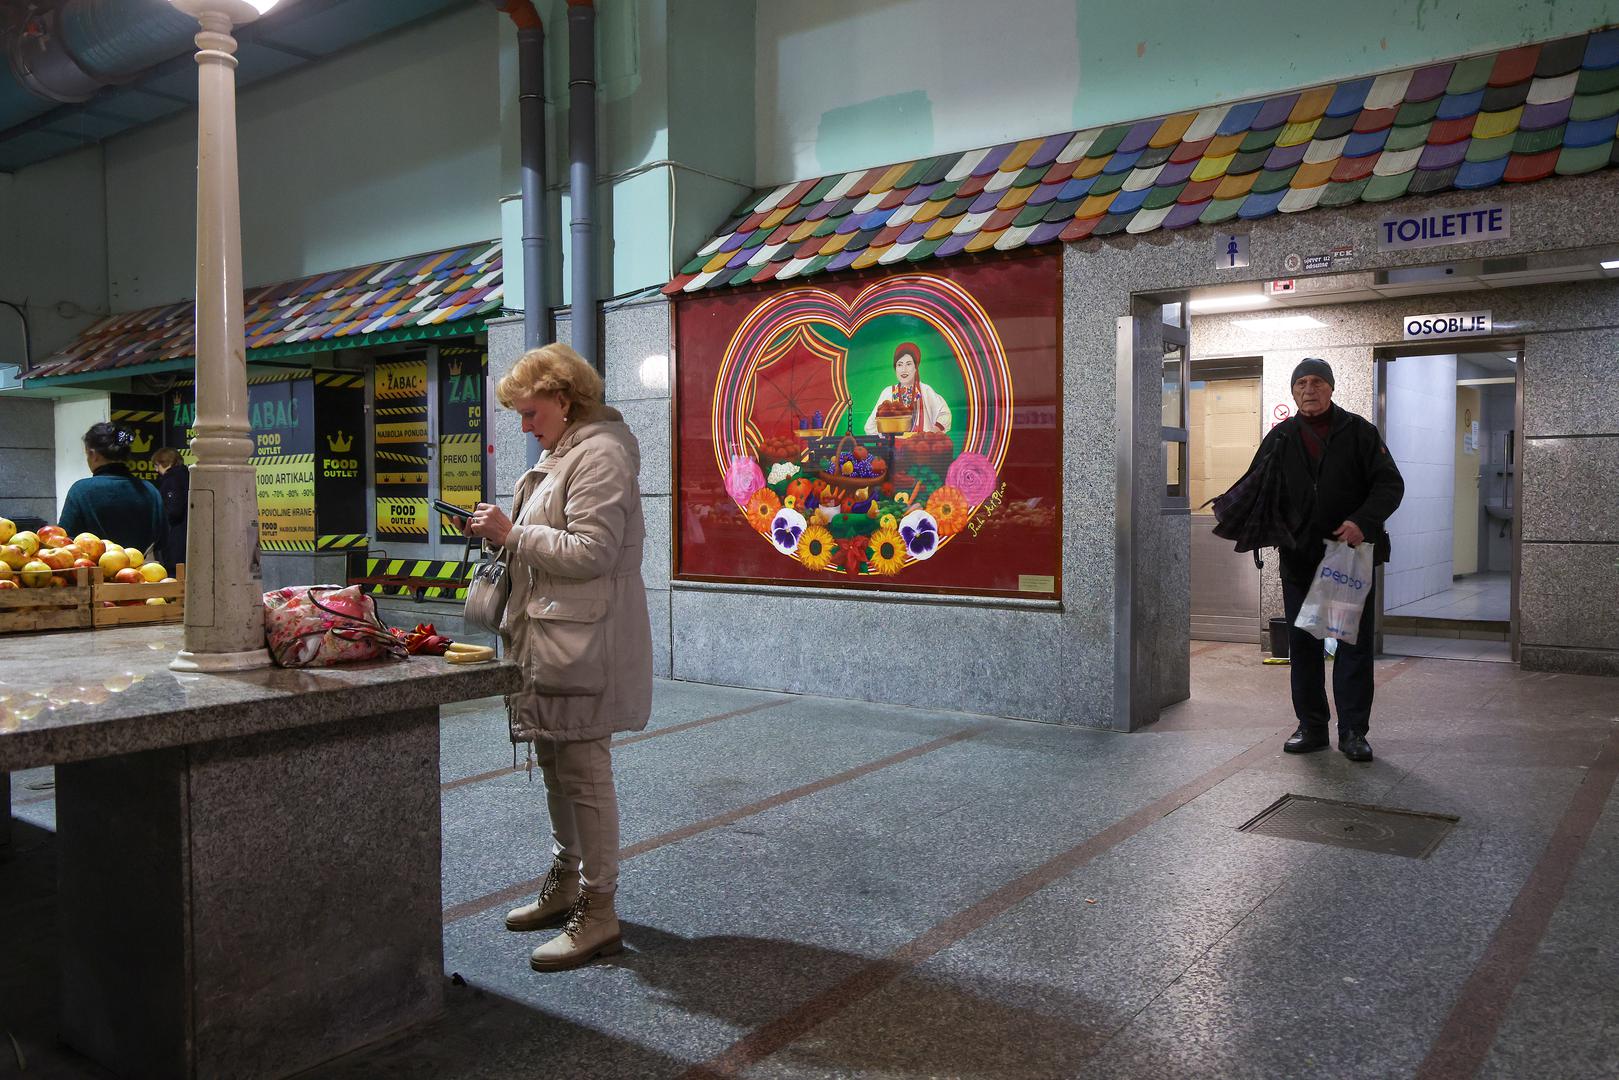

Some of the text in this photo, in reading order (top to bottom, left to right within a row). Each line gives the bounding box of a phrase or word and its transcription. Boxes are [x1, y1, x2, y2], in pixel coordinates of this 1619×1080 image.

[1383, 208, 1502, 243] TOILETTE
[1407, 315, 1486, 336] OSOBLJE
[257, 434, 281, 446] FOOD
[257, 446, 281, 455] OUTLET
[323, 459, 358, 469] FOOD
[443, 454, 468, 464] PREKO
[127, 460, 156, 472] OOD
[256, 472, 314, 485] 1000 ARTIKALA
[390, 505, 416, 516] FOOD
[261, 522, 277, 530] FOOD
[390, 517, 416, 525] OUTLET
